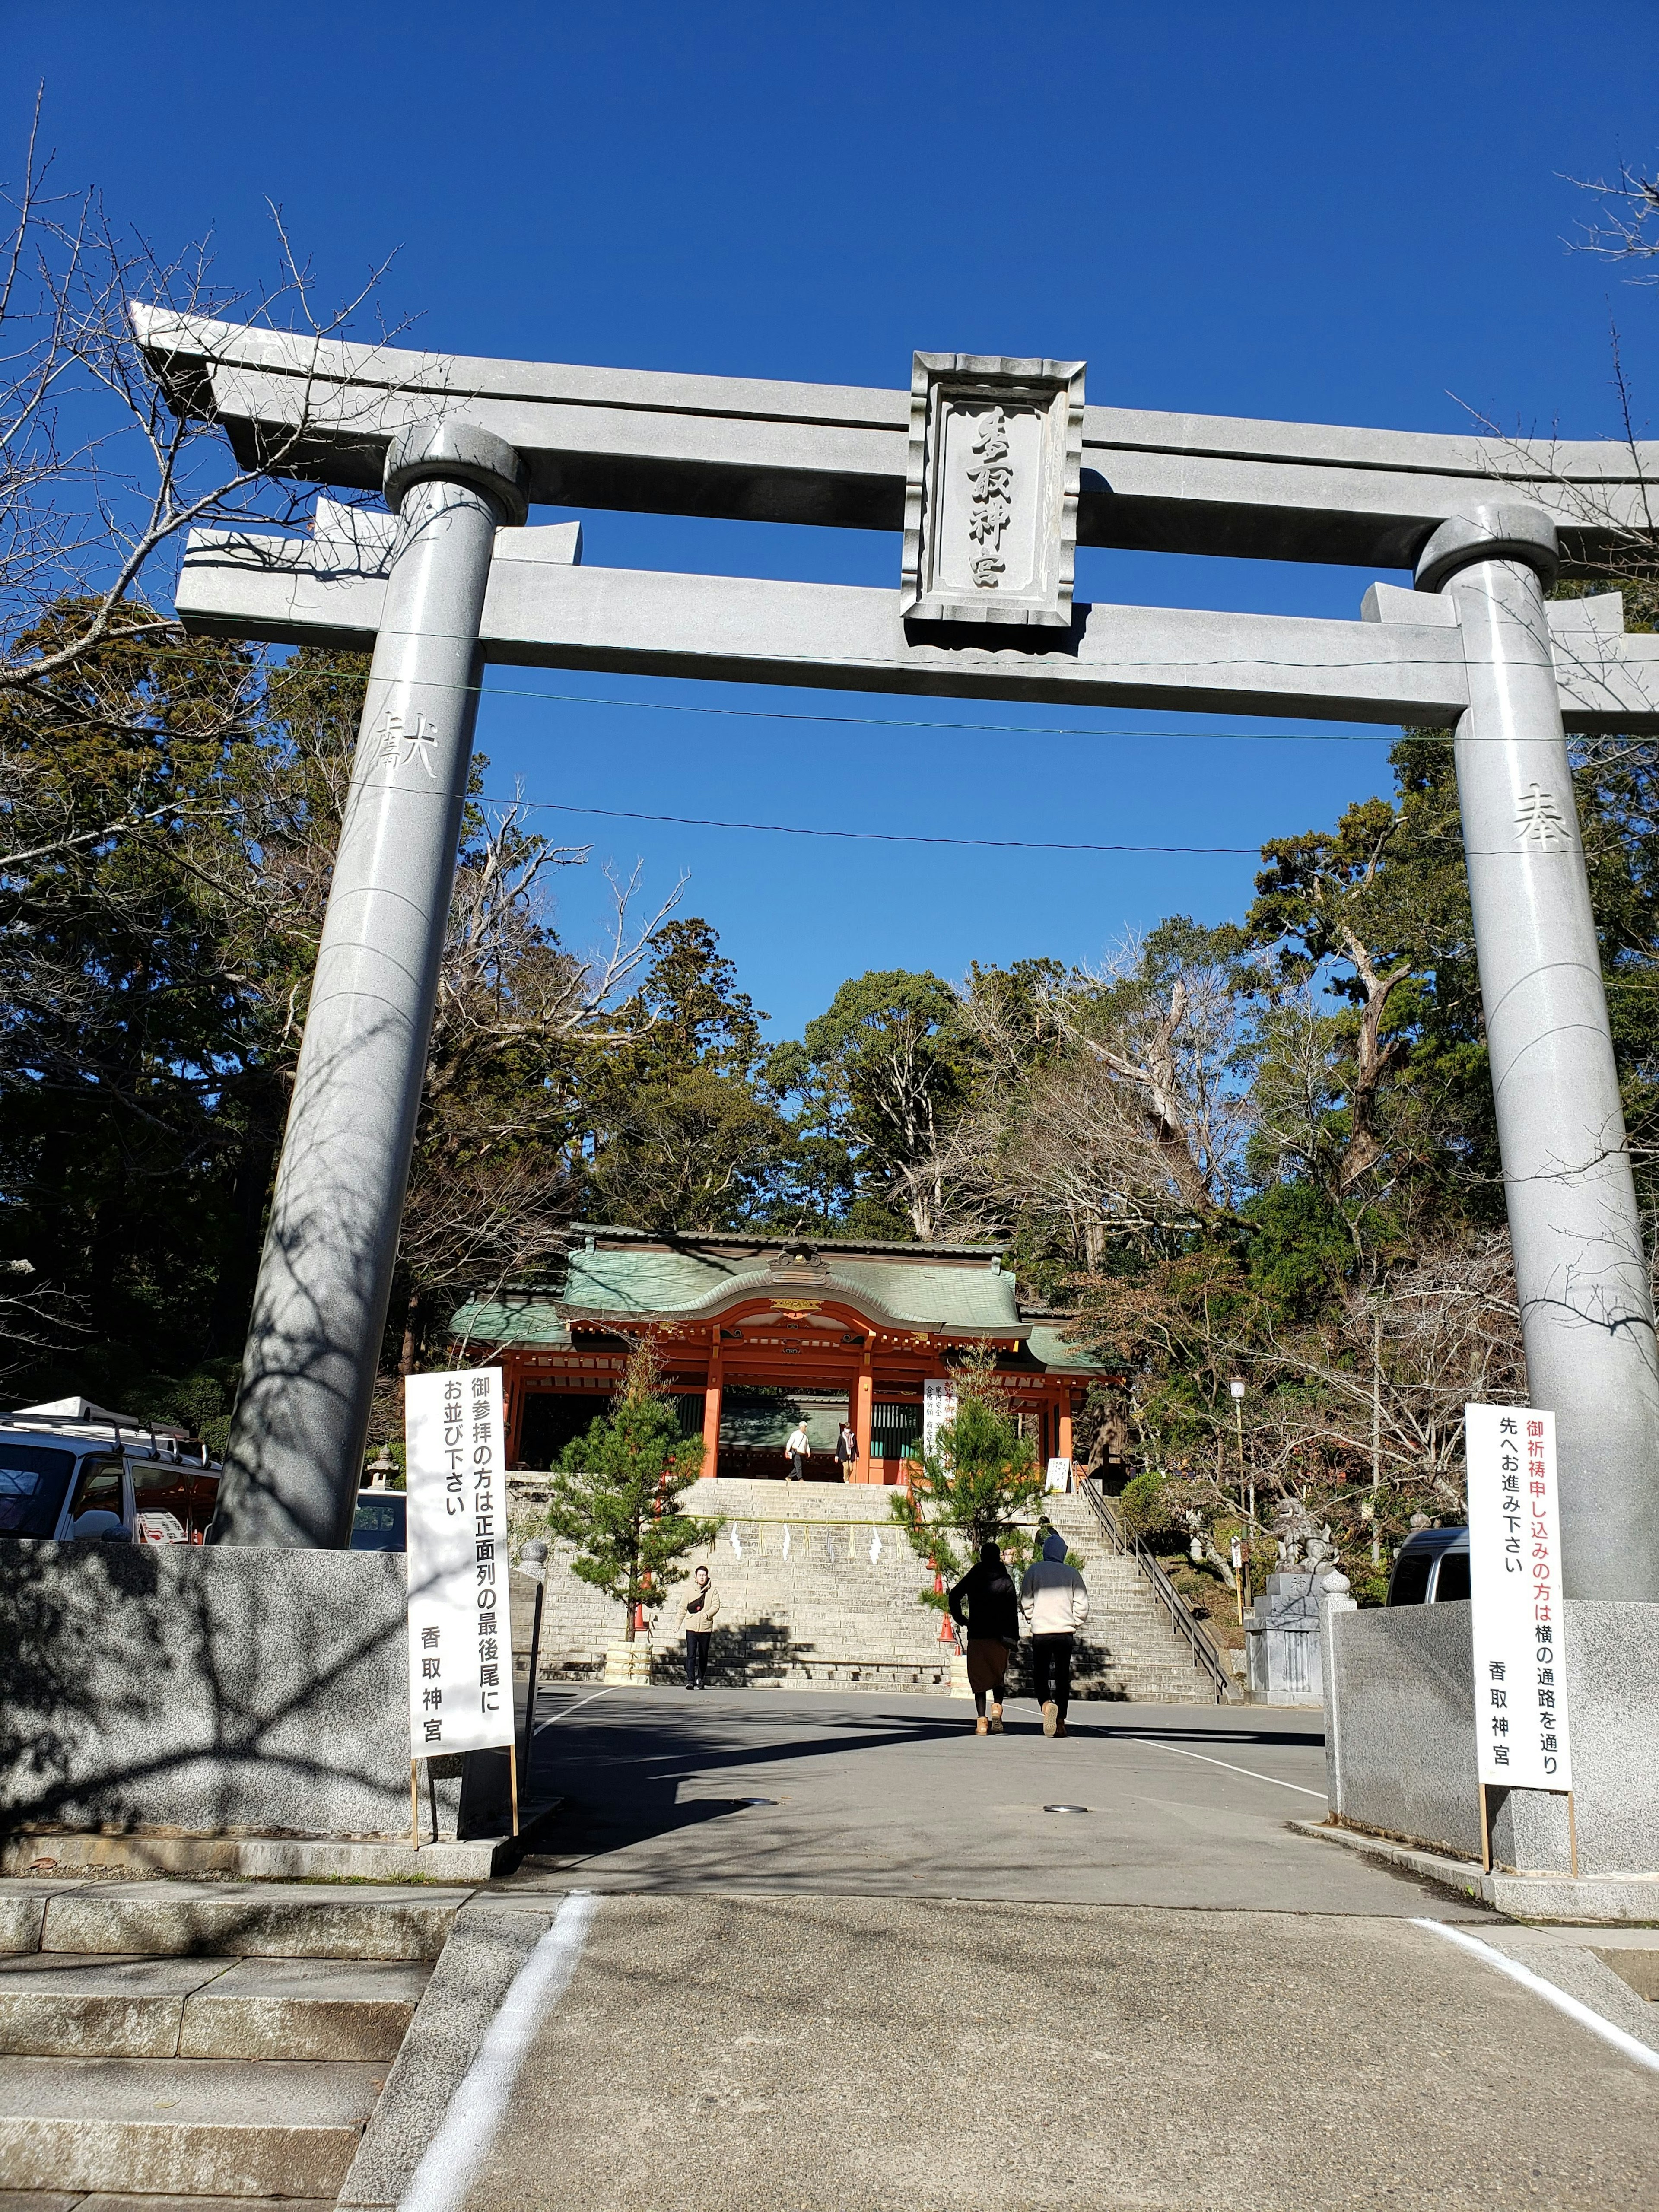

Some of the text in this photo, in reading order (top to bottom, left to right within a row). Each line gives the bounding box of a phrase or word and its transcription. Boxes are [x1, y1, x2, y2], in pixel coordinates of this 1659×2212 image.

[1512, 782, 1574, 851] 奉
[444, 1380, 465, 1516] お並び下さい
[1500, 1417, 1523, 1573] 先へお進み下さい
[471, 1376, 499, 1713] 御参拝の方は正面列の最後尾に
[1526, 1420, 1558, 1774] 御祈祷申し込みの方は横の通路を通り
[421, 1625, 442, 1743] 香取神宮
[1489, 1660, 1510, 1766] 香取神宮
